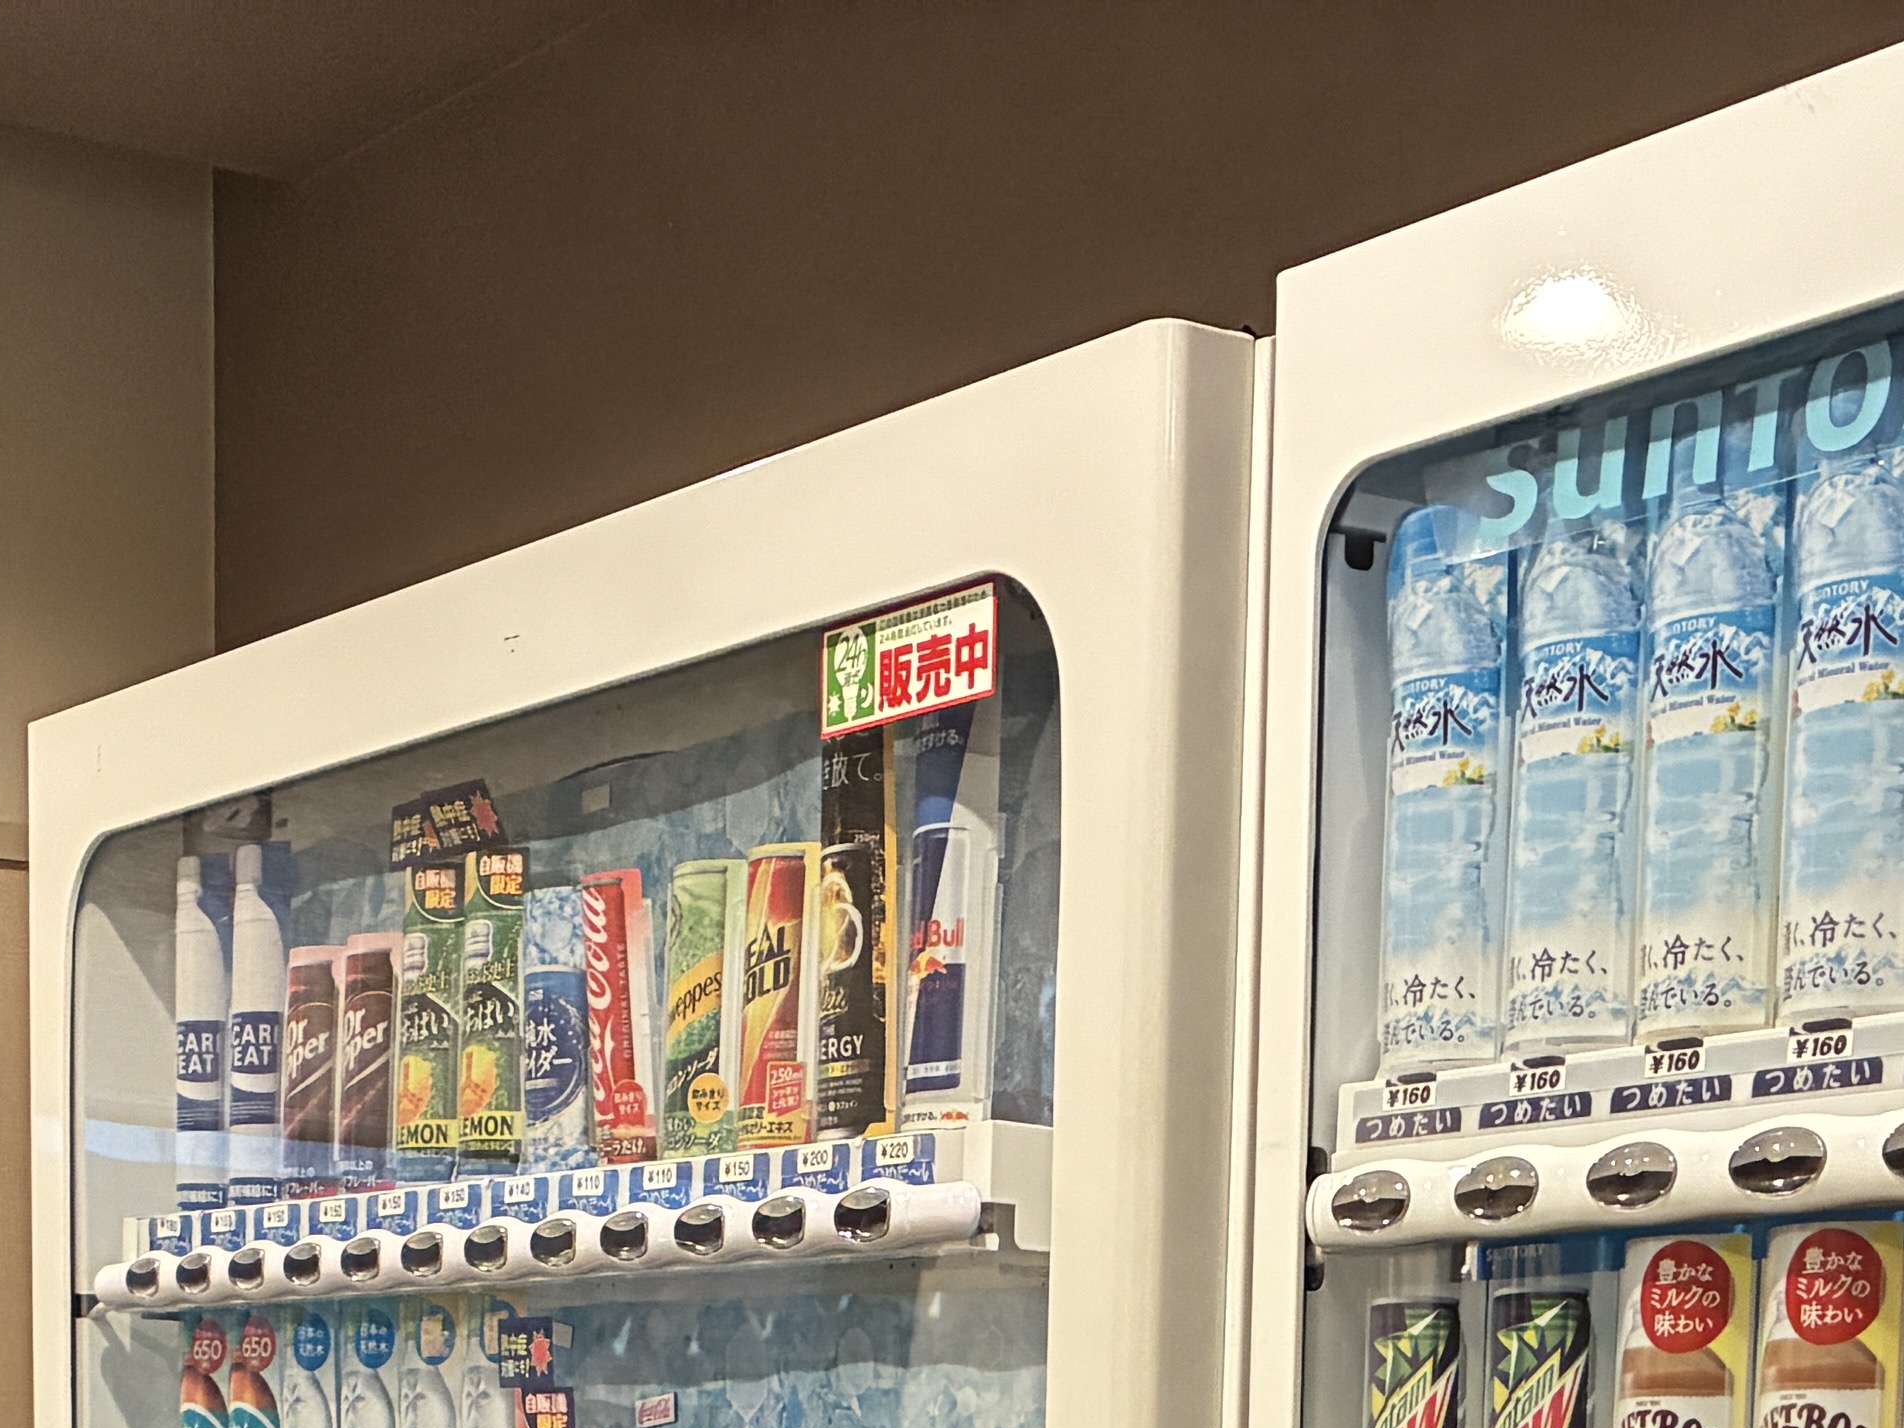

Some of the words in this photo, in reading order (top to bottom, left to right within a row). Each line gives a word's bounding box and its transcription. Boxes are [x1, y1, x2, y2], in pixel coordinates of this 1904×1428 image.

[878, 623, 988, 713] 販売中
[927, 918, 964, 947] Bull
[1649, 1051, 1700, 1072] ¥160
[1387, 1086, 1430, 1107] ¥160
[1366, 1114, 1452, 1139] つめたい
[801, 1149, 828, 1168] ¥200
[881, 1141, 909, 1159] ¥220
[725, 1160, 751, 1177] ¥150
[1803, 1248, 1863, 1273] 豊かな
[1657, 1260, 1712, 1284] 豊かな
[1796, 1276, 1869, 1299] ミルクの
[1651, 1289, 1720, 1309] ミルクの
[1655, 1313, 1712, 1336] 味わい
[1801, 1304, 1863, 1327] 味わい
[194, 1338, 222, 1360] 650
[242, 1335, 272, 1357] 650
